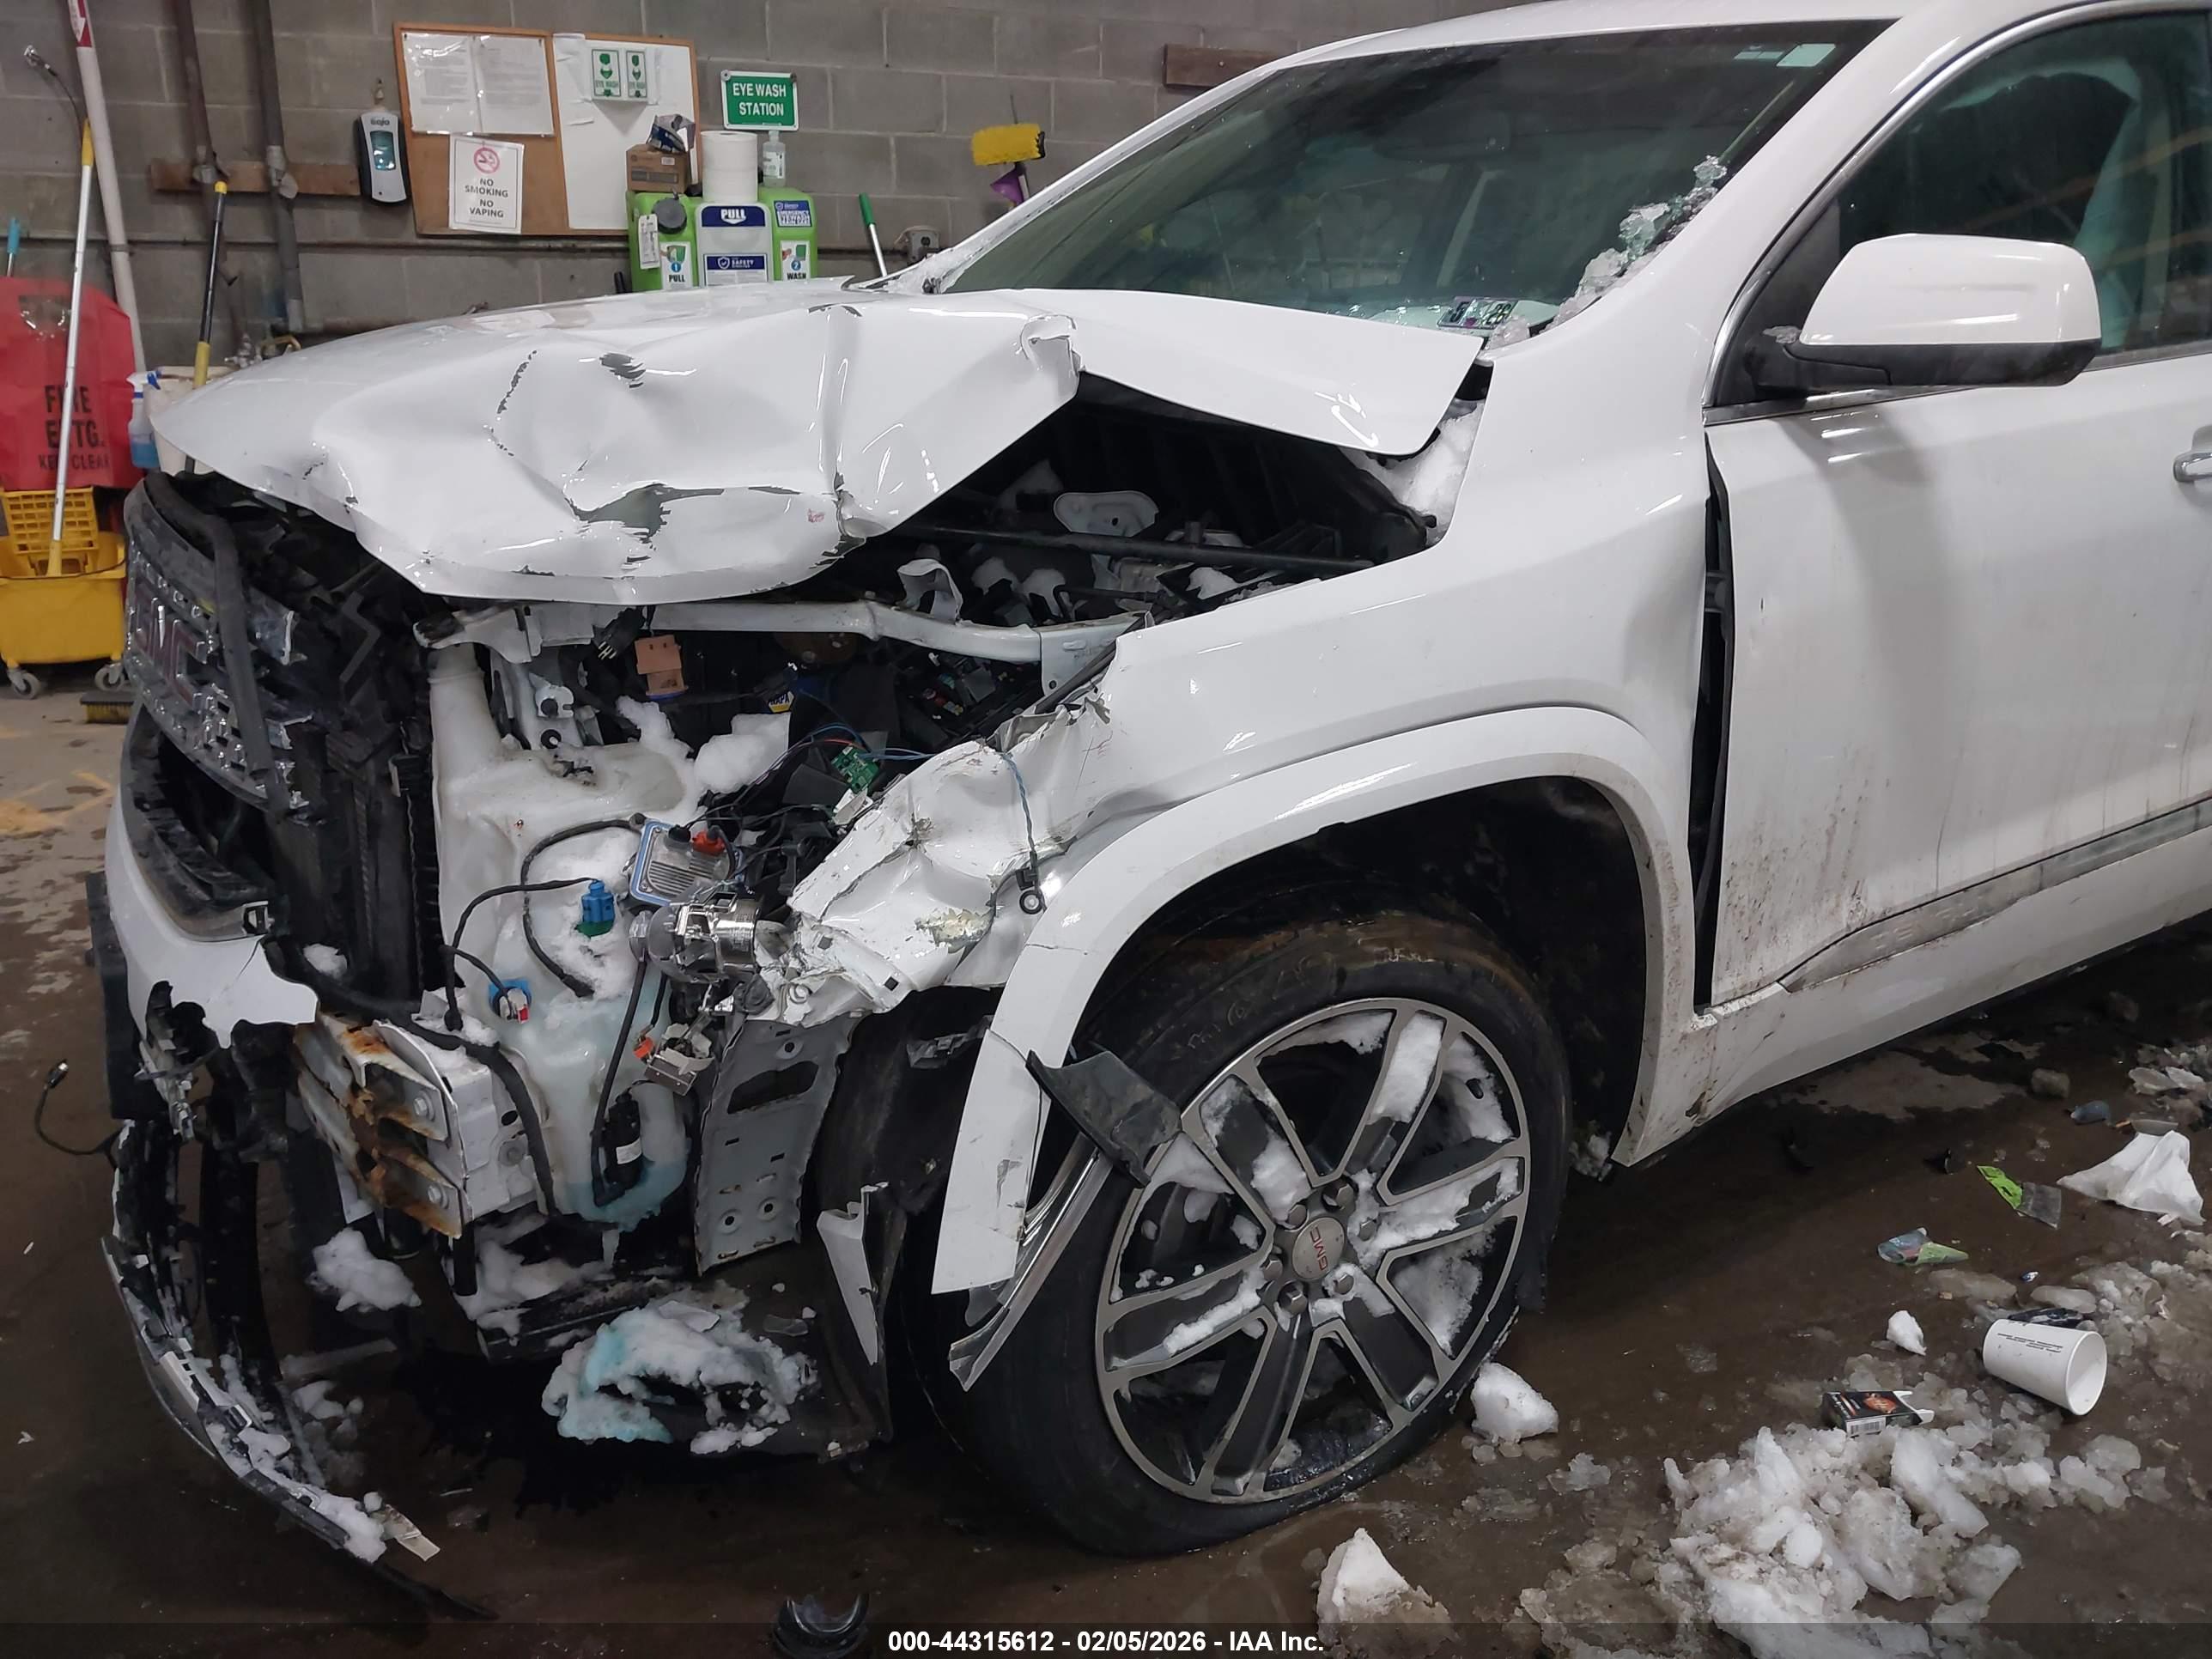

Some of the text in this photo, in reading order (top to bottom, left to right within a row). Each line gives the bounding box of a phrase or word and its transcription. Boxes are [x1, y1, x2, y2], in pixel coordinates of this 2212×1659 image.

[732, 82, 787, 97] EYE WASH
[739, 102, 784, 116] STATION
[465, 185, 508, 198] SMOKING
[469, 208, 504, 217] VAPING
[721, 209, 745, 220] PULL
[1310, 1226, 1328, 1271] GMC
